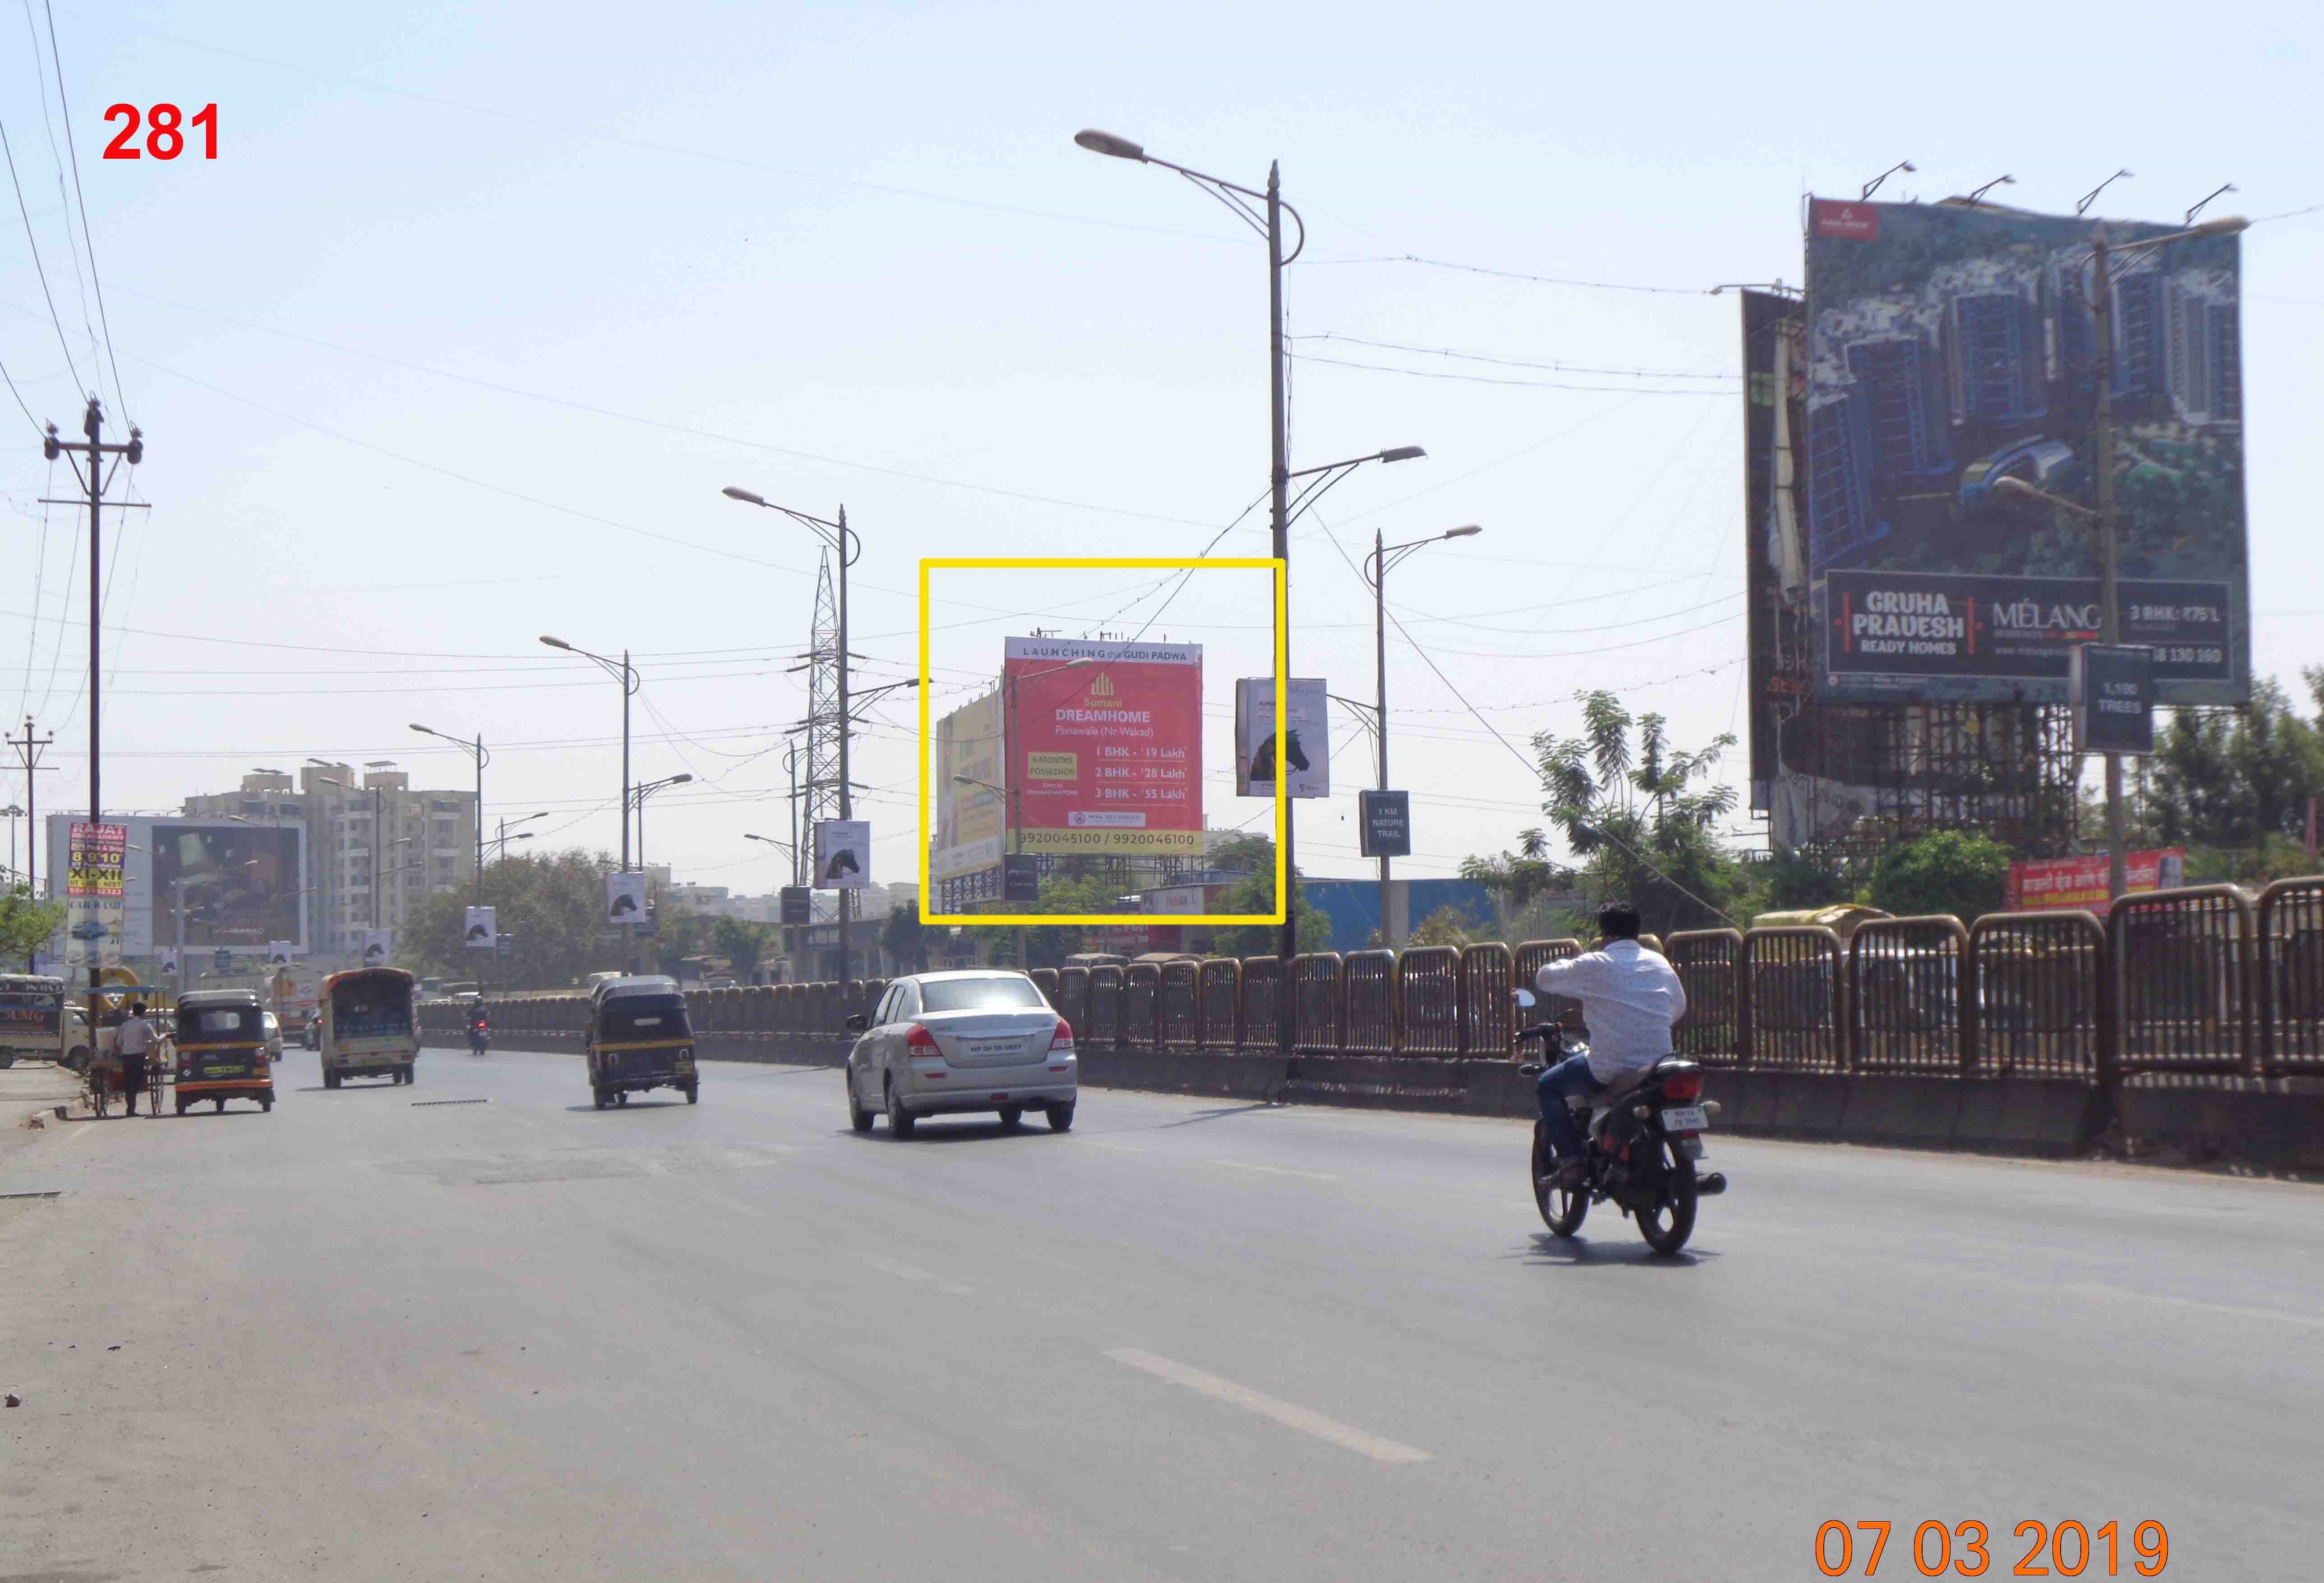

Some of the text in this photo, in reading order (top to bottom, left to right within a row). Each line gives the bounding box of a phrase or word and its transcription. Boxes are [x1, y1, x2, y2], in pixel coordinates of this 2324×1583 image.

[1867, 590, 1950, 615] GRUHA
[1992, 596, 2103, 630] MÉLANG
[1861, 639, 1956, 655] READY HOMES
[1023, 647, 1105, 658] LAUNCHING
[1124, 651, 1148, 659] GUDI
[1152, 651, 1186, 661] PADWA
[1084, 698, 1123, 708] Somani
[2097, 699, 2143, 714] TREES
[1055, 709, 1151, 722] DREAMHOME
[1055, 725, 1154, 739] Punawale (Nr Wakad)
[1097, 746, 1100, 756] 1
[1105, 746, 1130, 757] BHK
[1039, 755, 1072, 764] MONTHS
[1029, 768, 1076, 776] POSSESSION
[1096, 767, 1102, 776] 2
[1105, 767, 1130, 777] BHK
[1096, 787, 1101, 797] 3
[1105, 788, 1130, 798] BHK
[72, 823, 124, 835] RAJAT
[1372, 819, 1404, 827] NATURE
[1020, 833, 1101, 844] 9920045100
[1113, 833, 1194, 845] 9920046100
[1377, 829, 1400, 838] TRAIL
